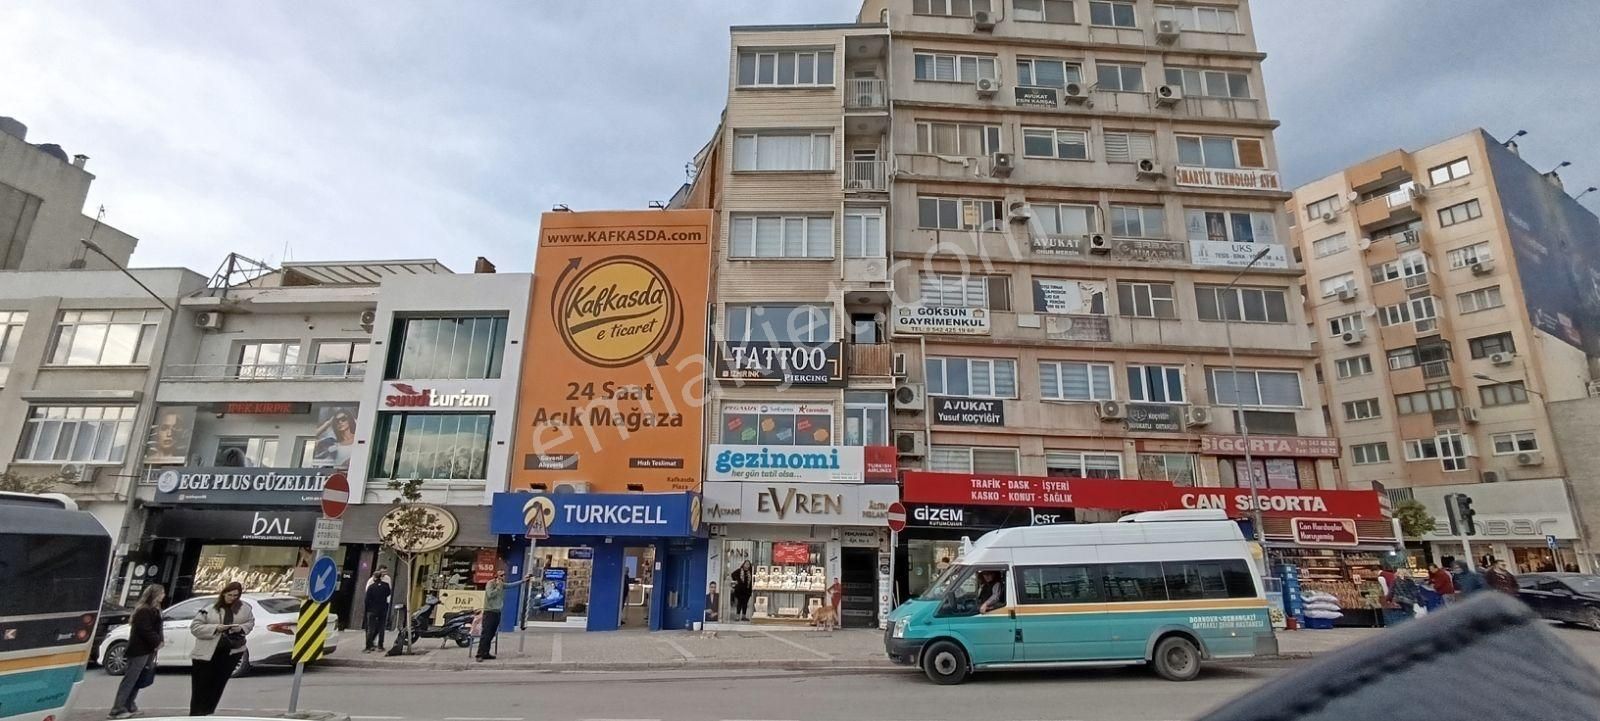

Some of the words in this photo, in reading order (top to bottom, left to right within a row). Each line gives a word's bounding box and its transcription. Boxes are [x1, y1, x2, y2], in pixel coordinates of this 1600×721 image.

[1215, 171, 1256, 188] TEKNOLOJİ
[547, 230, 702, 244] www.KAFKASDA.com
[1033, 238, 1080, 248] AVUKAT
[1231, 244, 1252, 253] UKS
[567, 276, 665, 319] Kafkasda
[610, 318, 657, 338] ticaret
[899, 316, 985, 326] GAYRİMENKUL
[731, 346, 827, 370] TATTOO
[784, 374, 828, 382] PIERCING
[566, 382, 595, 401] 24
[602, 381, 654, 401] Saat
[532, 407, 582, 432] Açık
[590, 407, 683, 432] Mağaza
[938, 412, 960, 421] Yusuf
[715, 448, 840, 473] gezinomi
[178, 473, 210, 490] EGE
[212, 473, 250, 490] PLUS
[731, 470, 749, 478] her
[761, 469, 777, 478] tatil
[971, 478, 1000, 488] TRAFİK
[1008, 480, 1030, 489] DASK
[1042, 480, 1070, 492] İŞYERİ
[757, 487, 843, 520] EVREN
[971, 491, 1000, 500] KASKO
[1008, 492, 1036, 501] KONUT
[1043, 491, 1073, 502] SAĞLIK
[1181, 494, 1227, 509] CAN
[564, 505, 667, 524] TURKCELL
[914, 505, 963, 521] GİZEM
